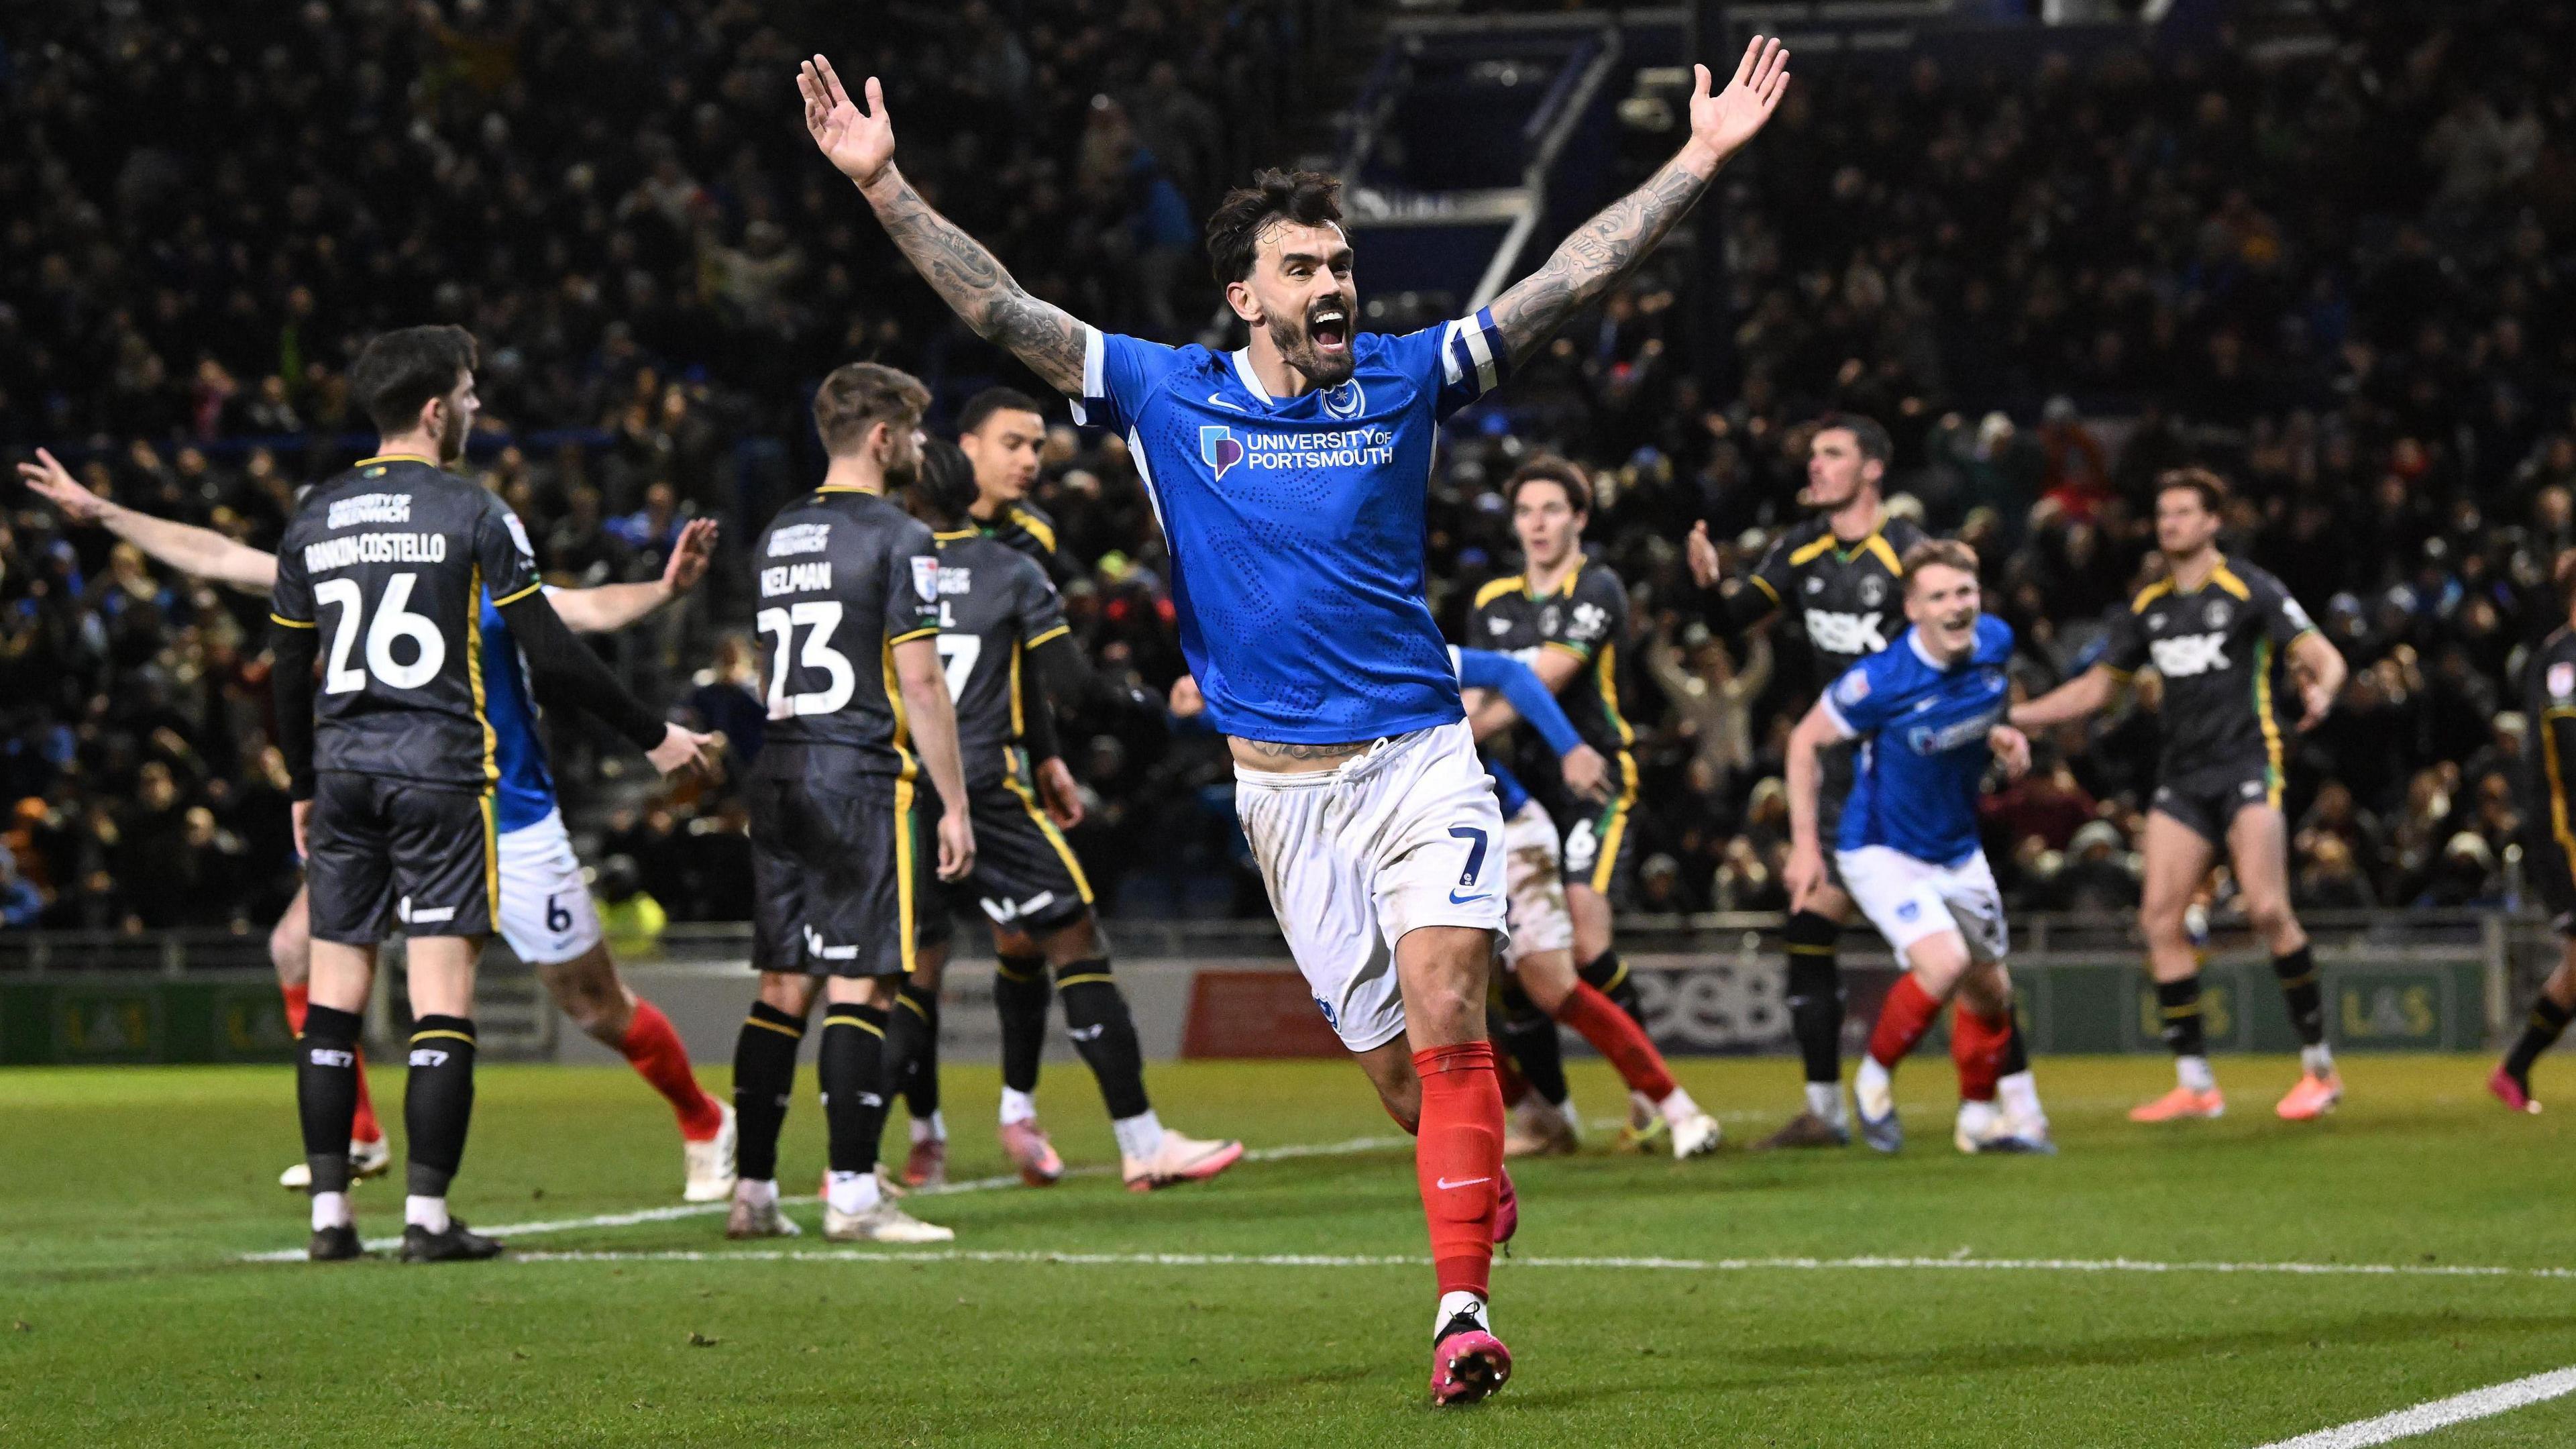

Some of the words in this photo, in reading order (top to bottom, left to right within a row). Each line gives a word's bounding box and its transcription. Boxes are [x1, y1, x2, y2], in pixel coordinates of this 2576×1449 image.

[1247, 429, 1376, 450] UNIVERSITY
[1375, 431, 1392, 444] OF
[1248, 447, 1393, 469] PORTSMOUTH
[761, 561, 832, 598] KELMAN
[314, 573, 446, 695] 26
[757, 600, 856, 721] 23
[1448, 826, 1489, 886] 7
[1565, 818, 1597, 858] 6
[546, 893, 572, 933] 6
